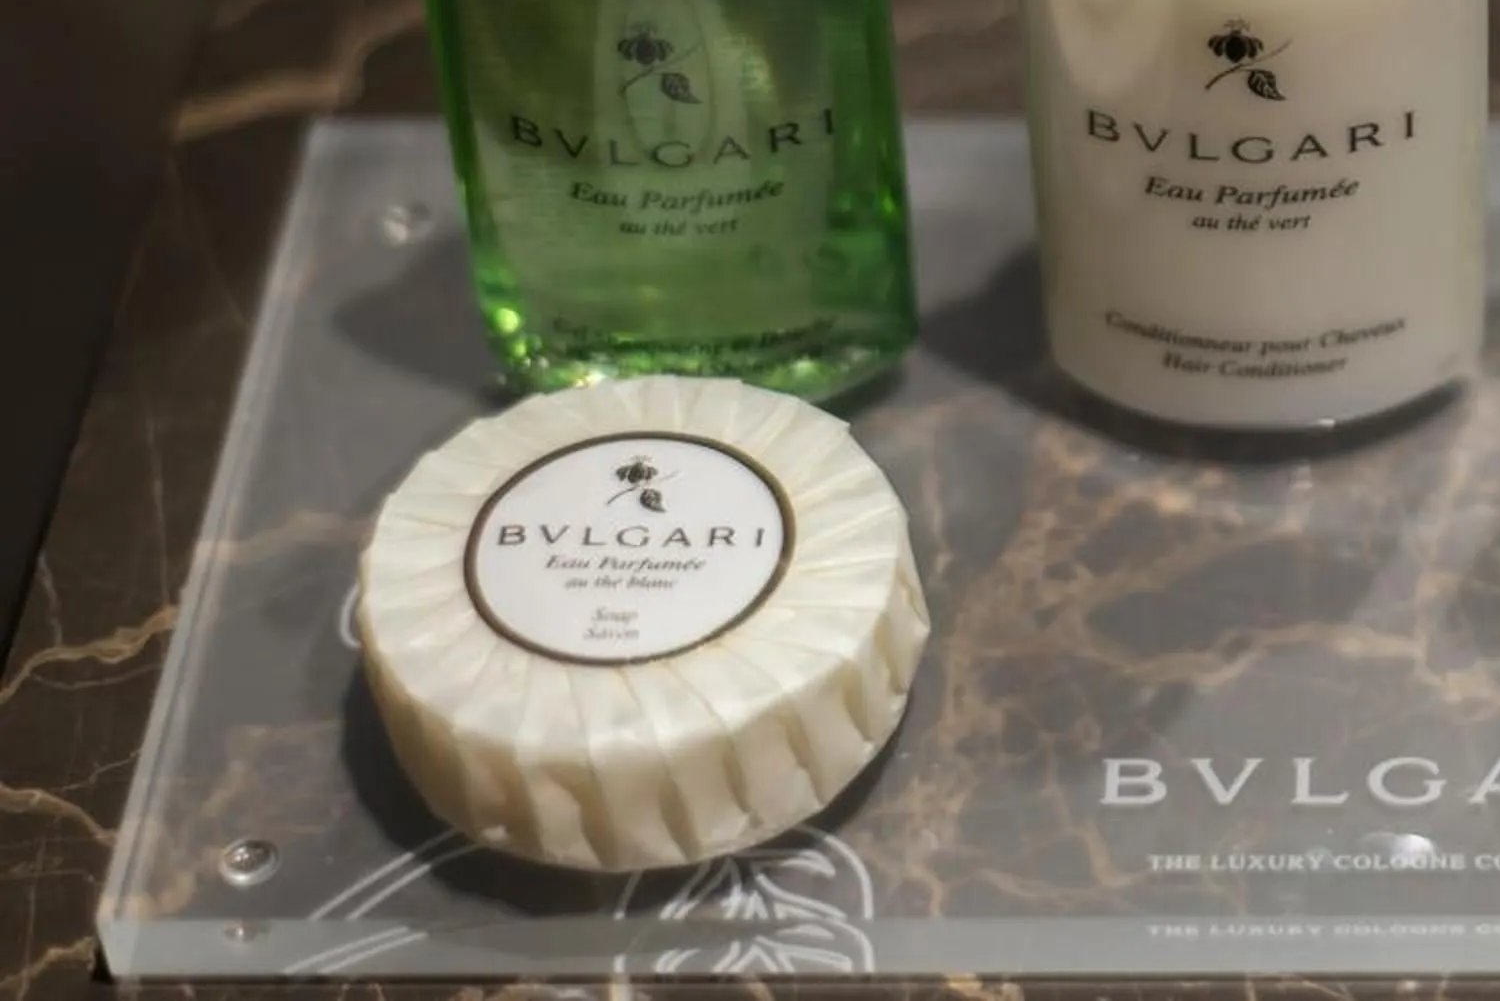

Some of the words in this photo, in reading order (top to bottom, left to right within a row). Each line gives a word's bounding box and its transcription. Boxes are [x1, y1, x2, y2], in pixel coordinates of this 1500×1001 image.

[510, 109, 834, 168] BVLGARI
[1087, 109, 1416, 164] BVLGARI
[568, 181, 628, 209] Eau
[640, 179, 785, 214] Parfumée
[1145, 176, 1203, 203] Eau
[1215, 177, 1360, 209] Parfumée
[619, 220, 646, 235] au
[700, 217, 738, 235] vert
[1192, 214, 1219, 230] au
[1226, 212, 1260, 231] thé
[1269, 212, 1311, 230] vert
[1260, 337, 1310, 356] pour
[497, 524, 766, 548] BVLGARI
[545, 554, 591, 571] Eau
[1149, 853, 1200, 871] THE
[1211, 853, 1324, 872] LUXURY
